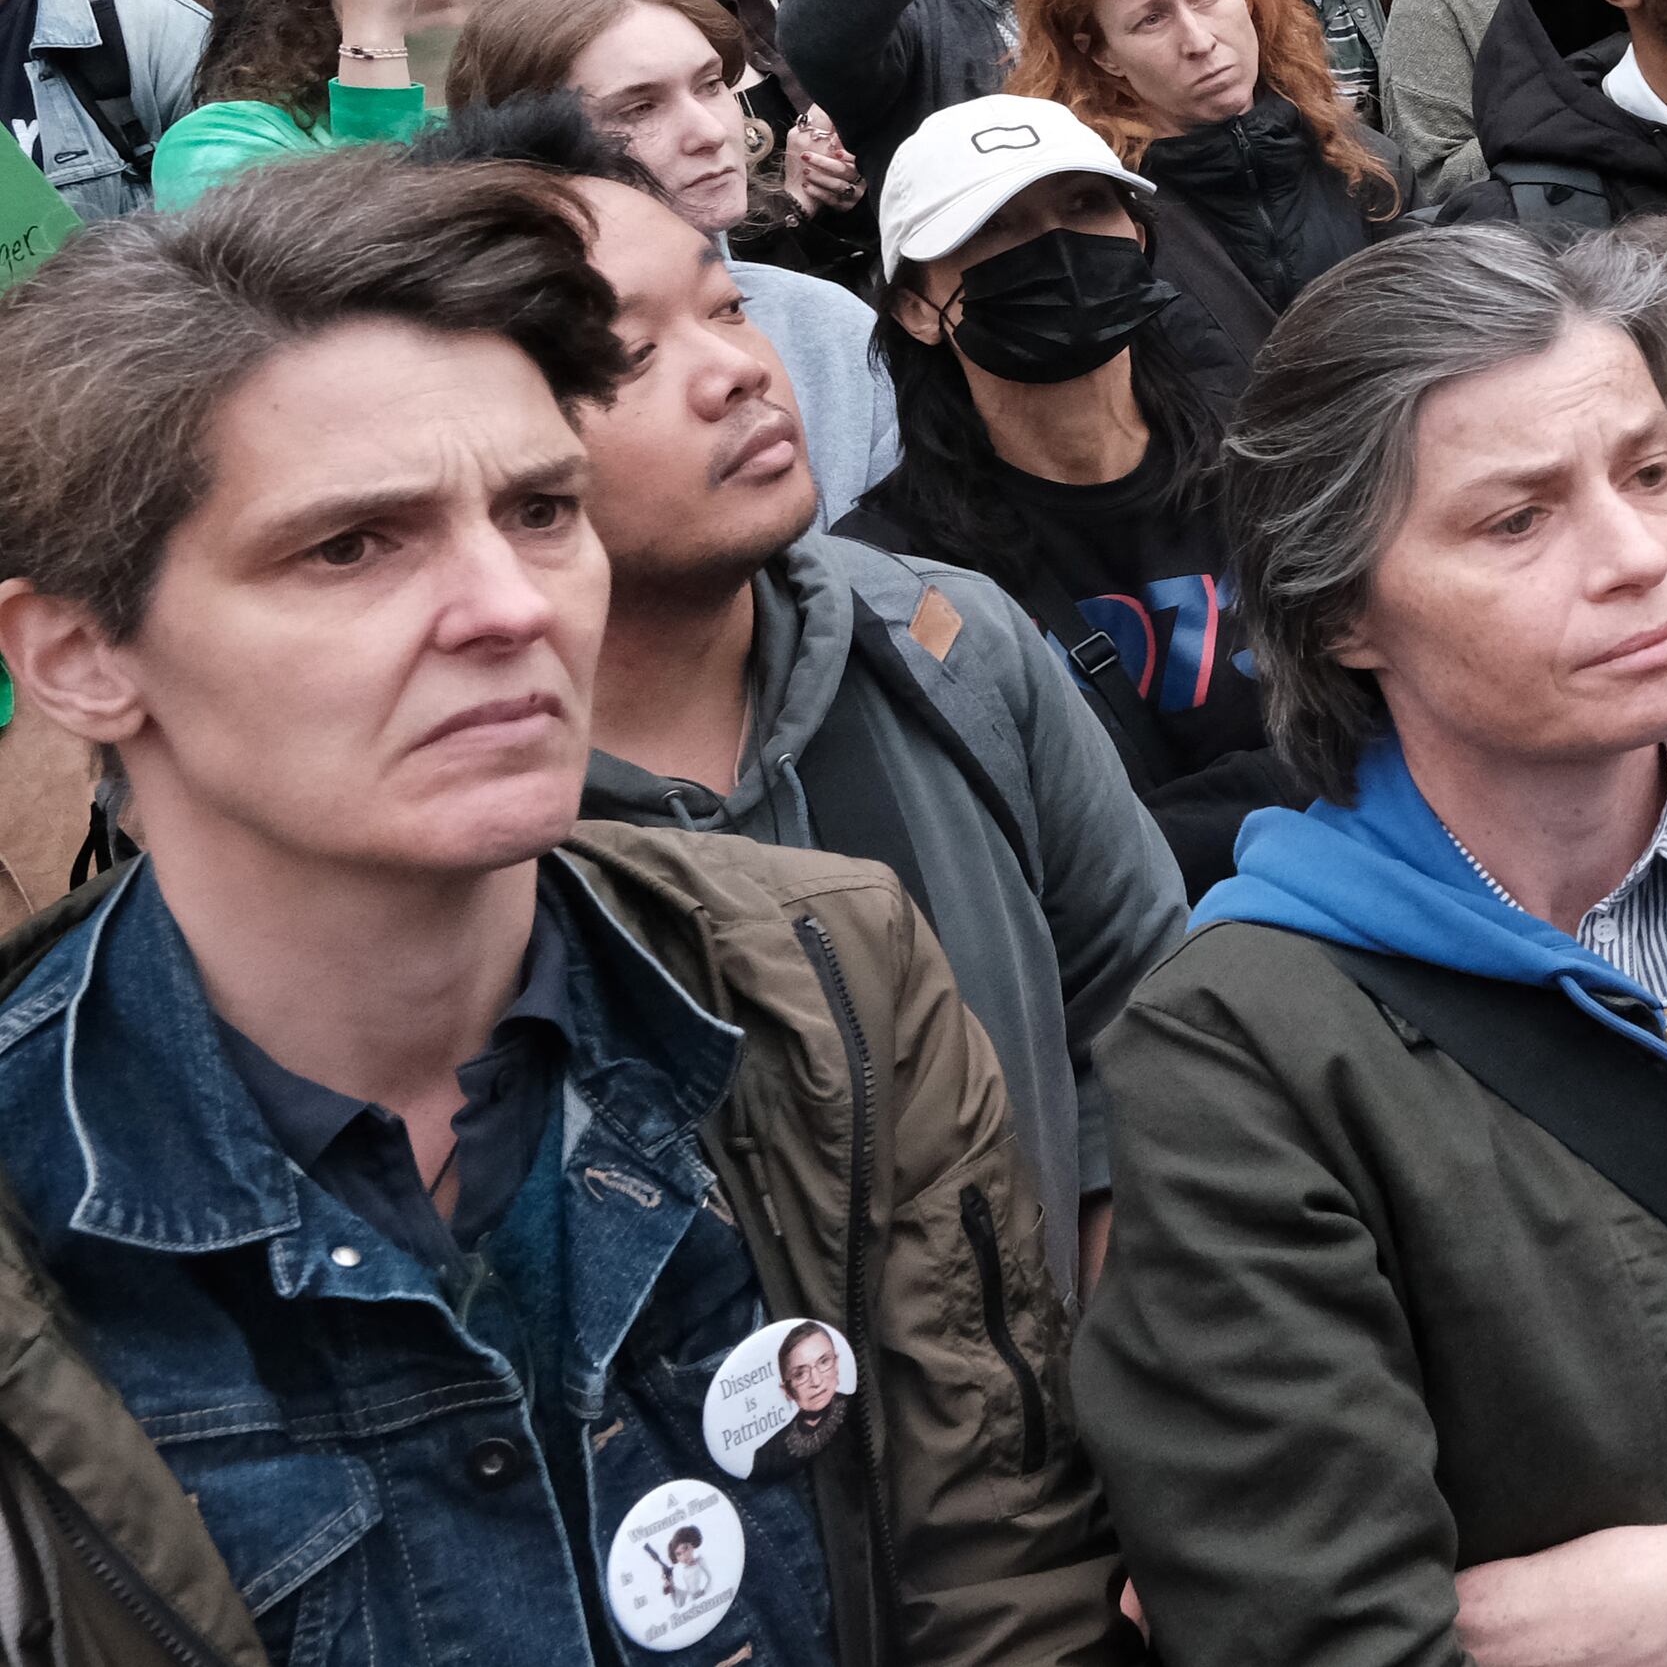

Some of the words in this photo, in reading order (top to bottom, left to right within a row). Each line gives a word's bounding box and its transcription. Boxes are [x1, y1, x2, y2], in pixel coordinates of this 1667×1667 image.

[719, 1361, 776, 1402] Dissent
[744, 1397, 758, 1414] is
[721, 1406, 788, 1452] Patriotic
[666, 1493, 680, 1510] A
[627, 1507, 688, 1544] Woman's
[644, 1618, 669, 1642] the
[670, 1585, 735, 1631] Resistance
